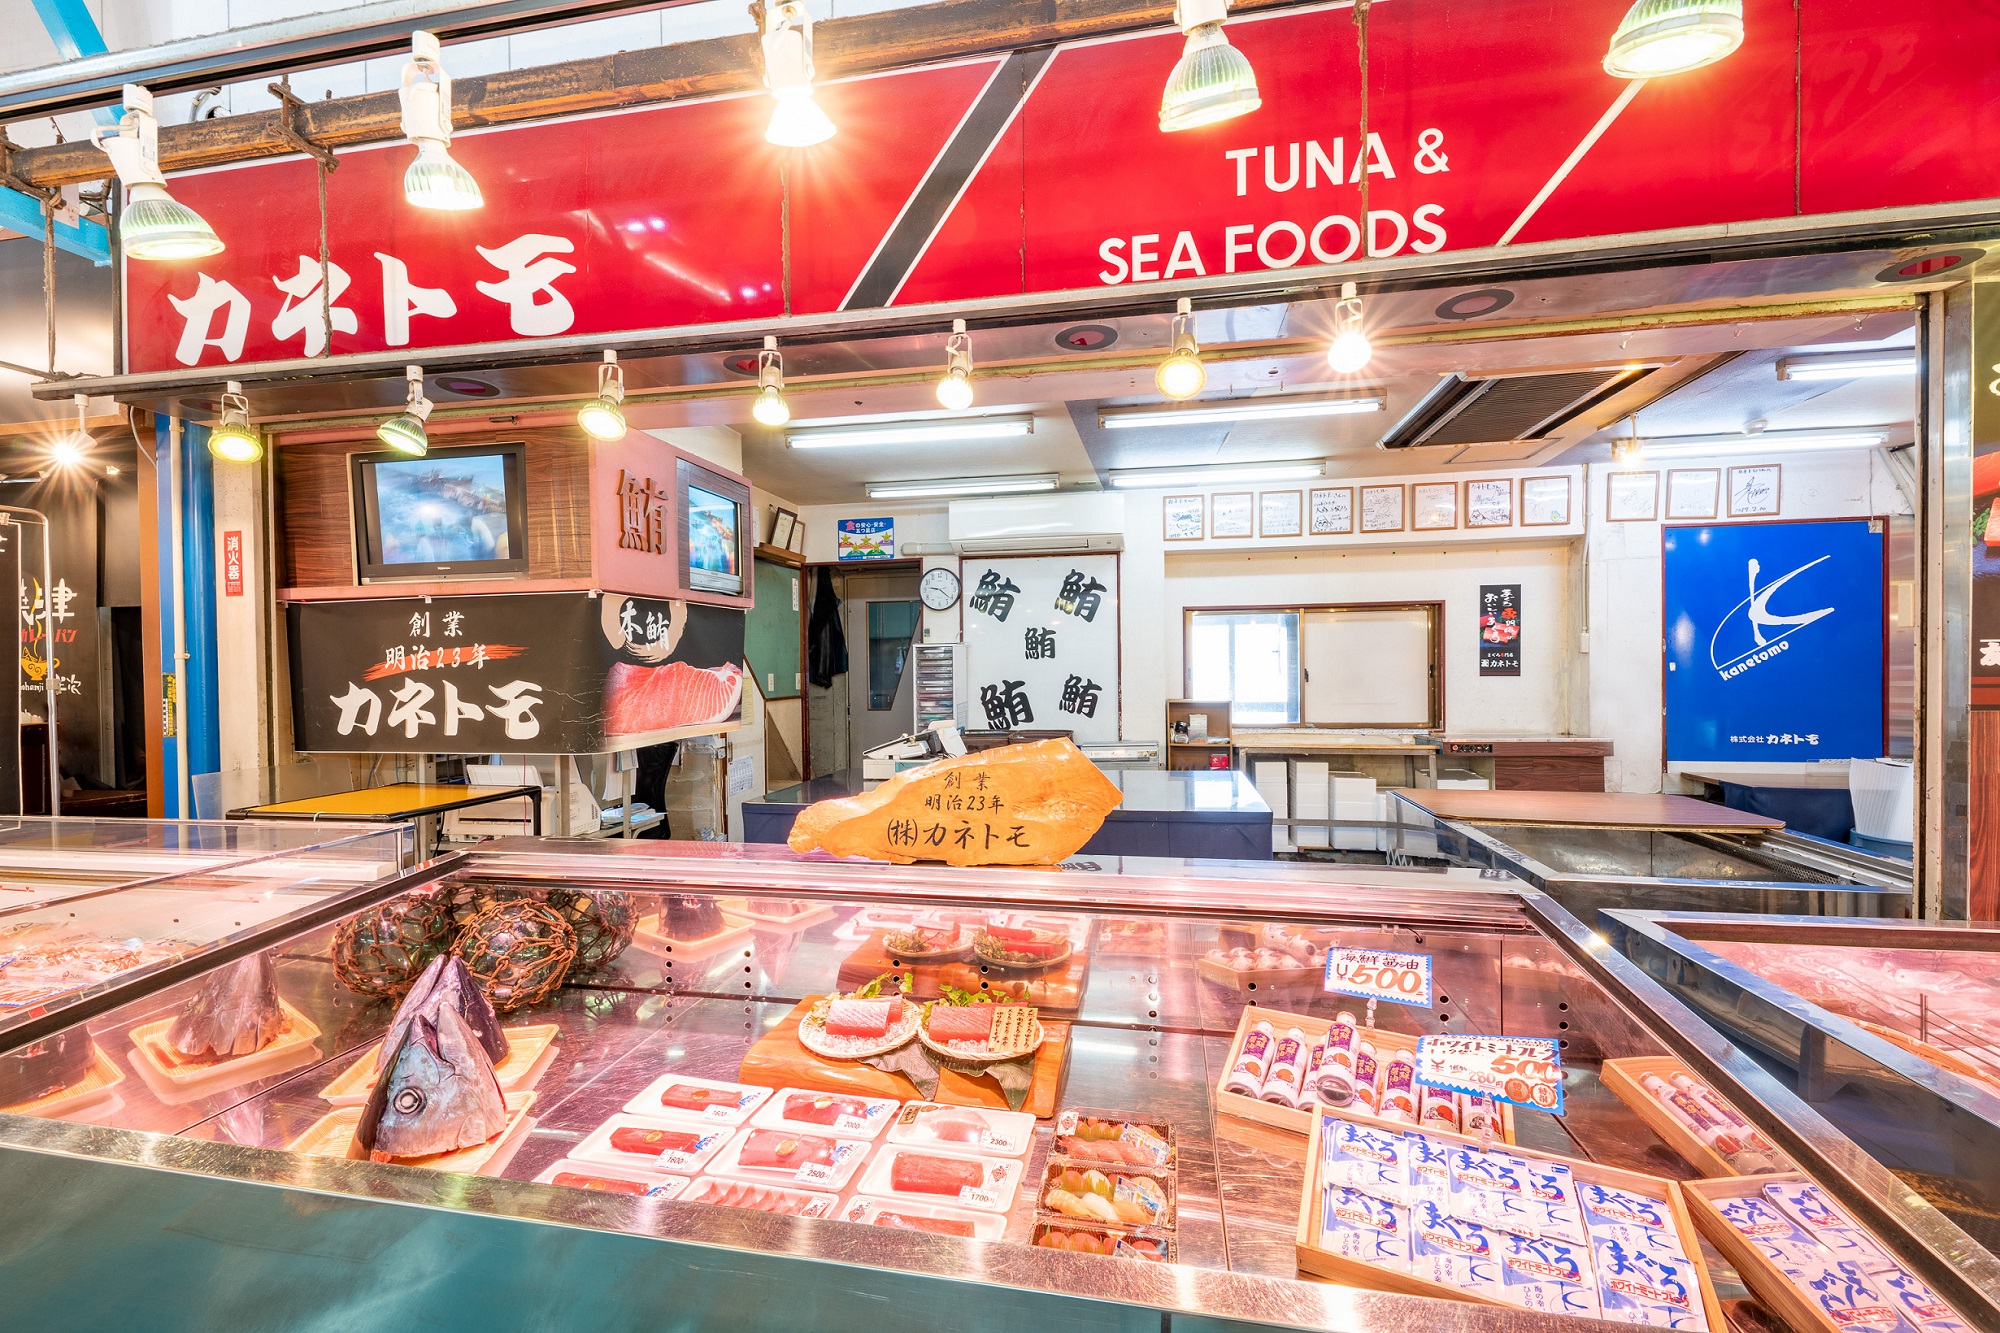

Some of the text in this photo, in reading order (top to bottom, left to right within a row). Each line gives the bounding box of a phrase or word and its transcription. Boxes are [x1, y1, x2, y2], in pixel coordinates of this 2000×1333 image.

[1226, 126, 1451, 196] TUNA &
[1098, 202, 1449, 286] SEA FOODS
[167, 233, 577, 366] カネトモ
[617, 469, 669, 555] 鮪
[227, 536, 240, 580] 消火器
[969, 568, 1021, 623] 鮪
[1054, 568, 1107, 623] 鮪
[408, 611, 465, 638] 創業
[618, 600, 670, 652] 本鮪
[1025, 627, 1056, 660] 鮪
[384, 643, 491, 671] 明治23年
[1719, 639, 1790, 682] kanetomo
[330, 677, 544, 740] カネトモ
[980, 679, 1035, 731] 鮪
[1059, 674, 1103, 719] 鮪
[924, 794, 1005, 815] 明治23年
[944, 771, 992, 790] 創業
